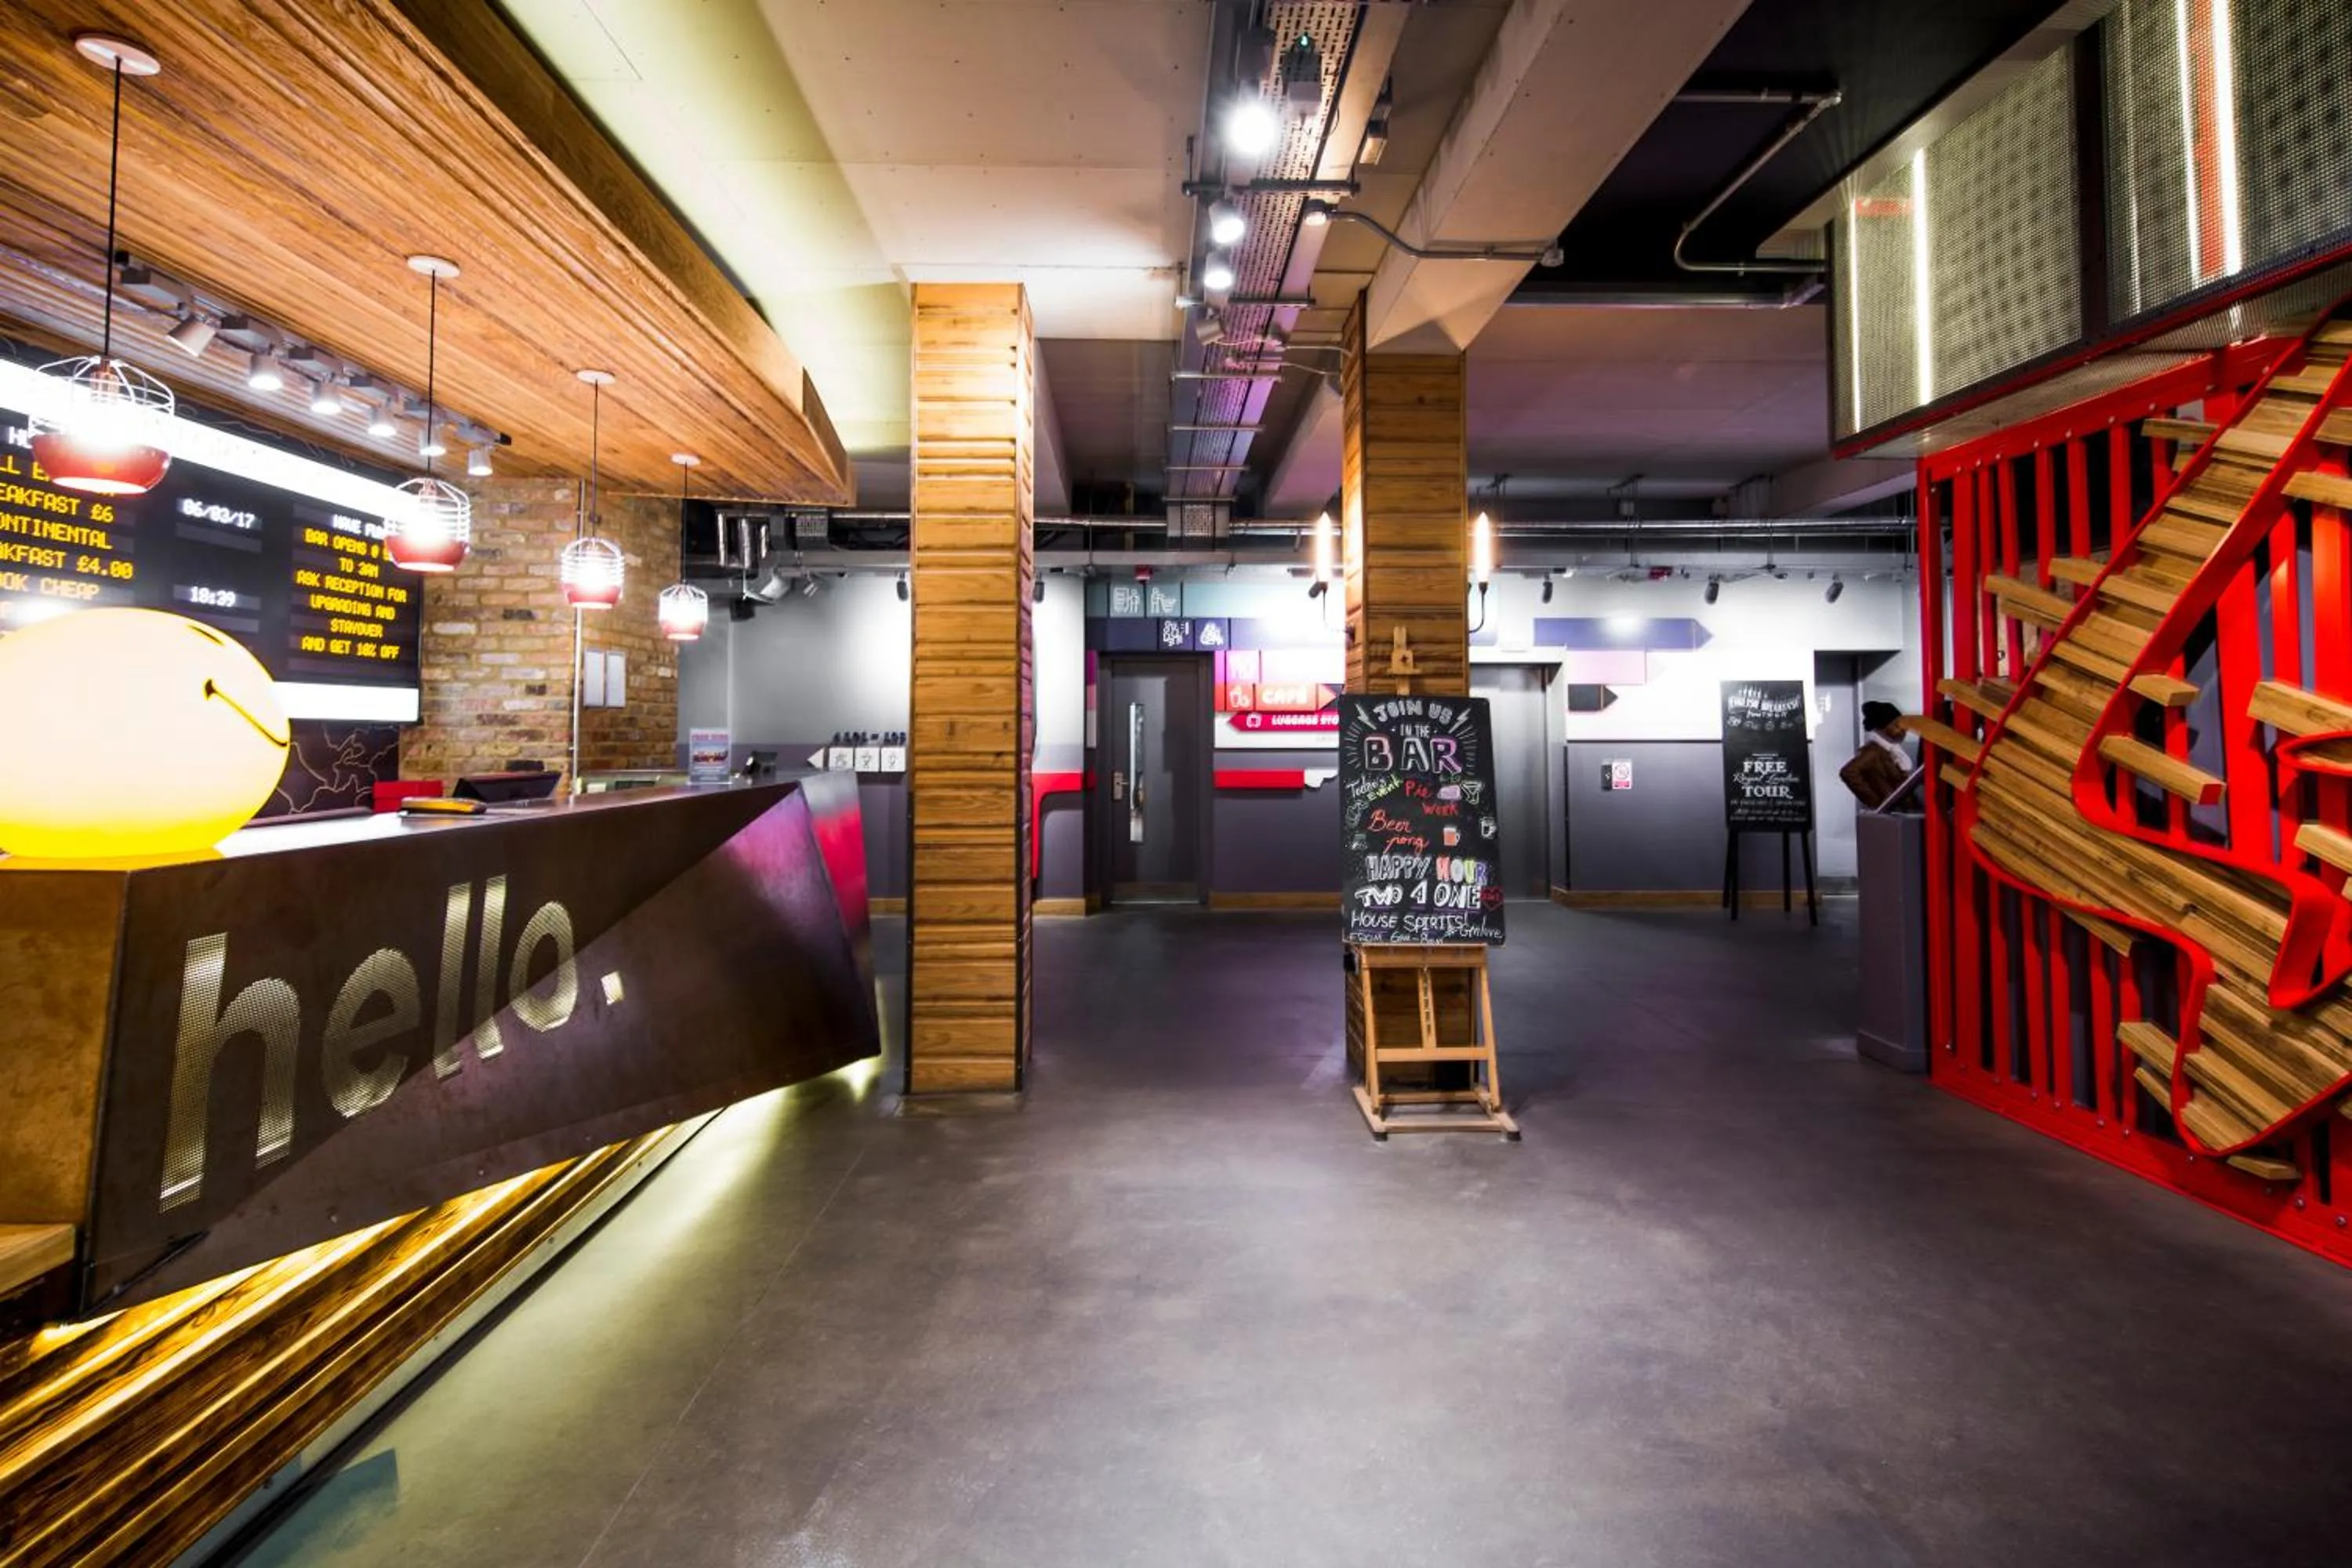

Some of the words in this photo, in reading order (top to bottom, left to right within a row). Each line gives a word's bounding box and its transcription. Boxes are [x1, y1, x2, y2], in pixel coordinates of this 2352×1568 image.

[90, 503, 114, 523] £6
[304, 528, 328, 546] BAR
[332, 535, 367, 556] OPENS
[76, 555, 133, 579] £4.00
[339, 557, 354, 572] TO
[40, 576, 100, 601] CHEAP
[296, 570, 320, 586] ASK
[325, 575, 384, 599] RECEPTION
[387, 587, 407, 602] FOR
[376, 605, 395, 620] AND
[301, 636, 325, 652] AND
[330, 639, 351, 655] GET
[380, 644, 400, 659] OFF
[1272, 714, 1318, 725] LUGGAGE
[1373, 700, 1423, 722] JOIN
[1428, 702, 1453, 724] US
[1400, 724, 1412, 736] IN
[1414, 724, 1430, 738] THE
[1364, 736, 1462, 774] BAR
[1743, 760, 1787, 775] FREE
[1741, 785, 1794, 799] TOUR
[1367, 855, 1432, 881] HAPPY
[1436, 856, 1487, 886] HOUR
[1355, 884, 1403, 907] TWO
[1410, 880, 1428, 904] 4
[1434, 882, 1481, 909] ONE
[1351, 909, 1399, 928] HOUSE
